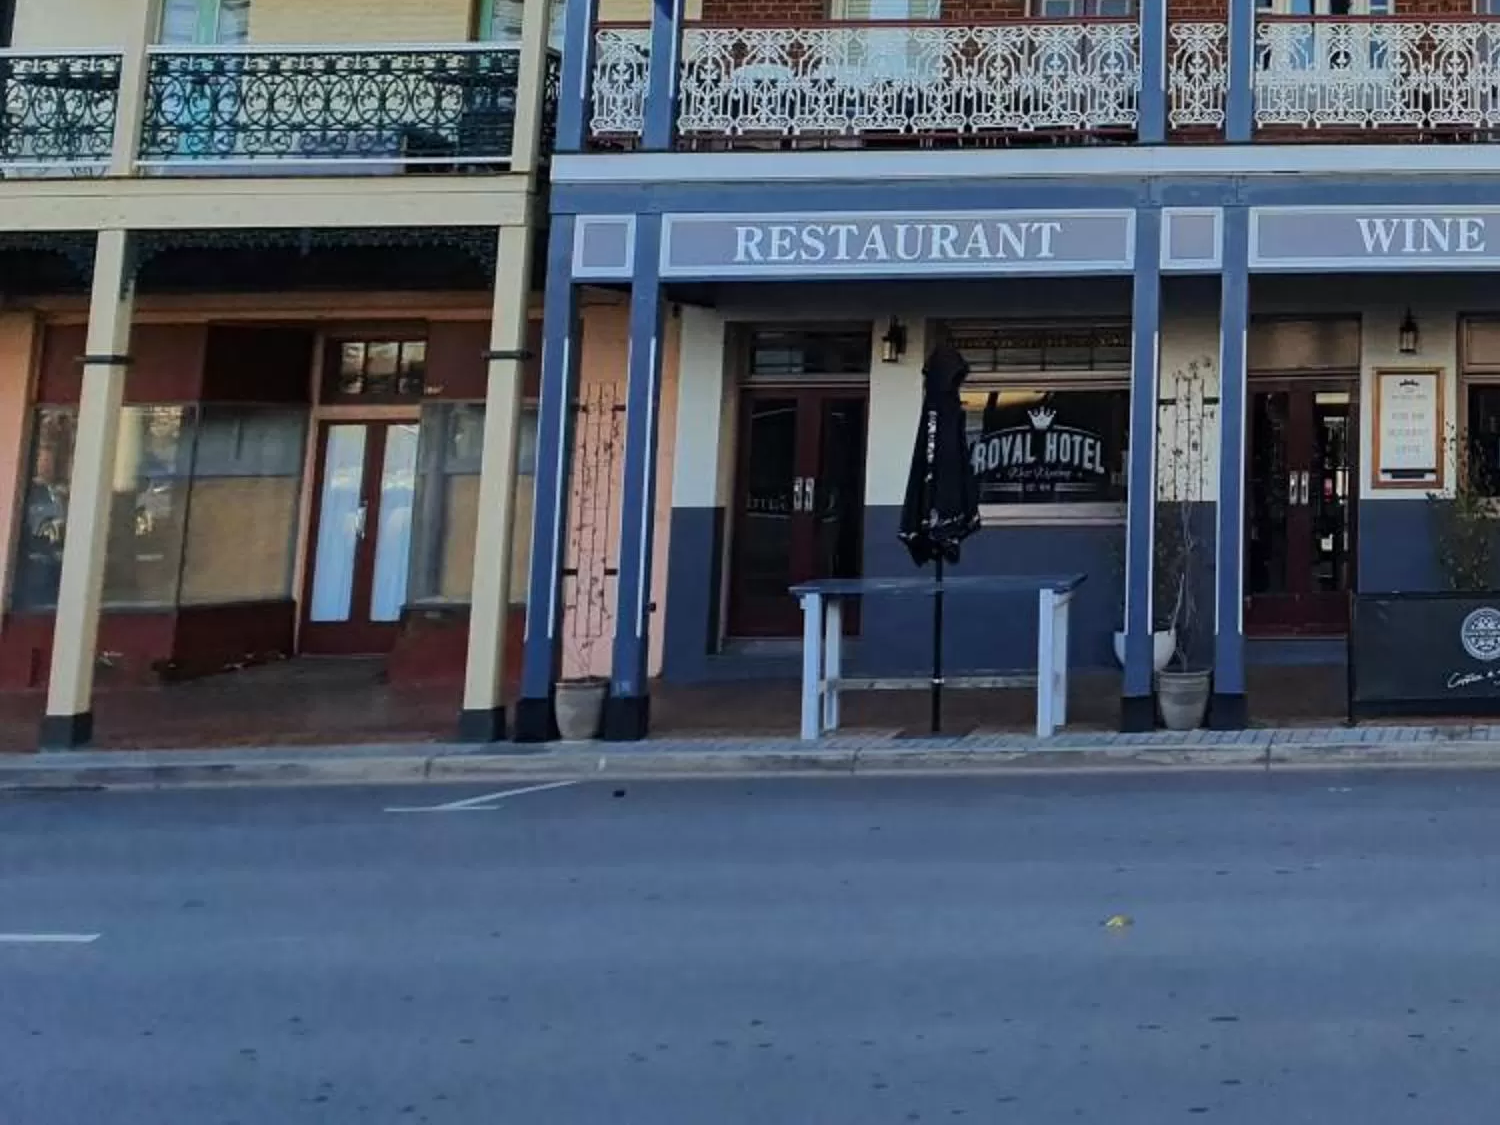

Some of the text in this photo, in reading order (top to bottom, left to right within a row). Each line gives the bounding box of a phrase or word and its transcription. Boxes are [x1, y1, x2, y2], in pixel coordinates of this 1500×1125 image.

[733, 222, 1062, 261] RESTAURANT
[1356, 217, 1487, 253] WINE
[972, 432, 1036, 475] ROYAL
[1045, 432, 1104, 474] HOTEL
